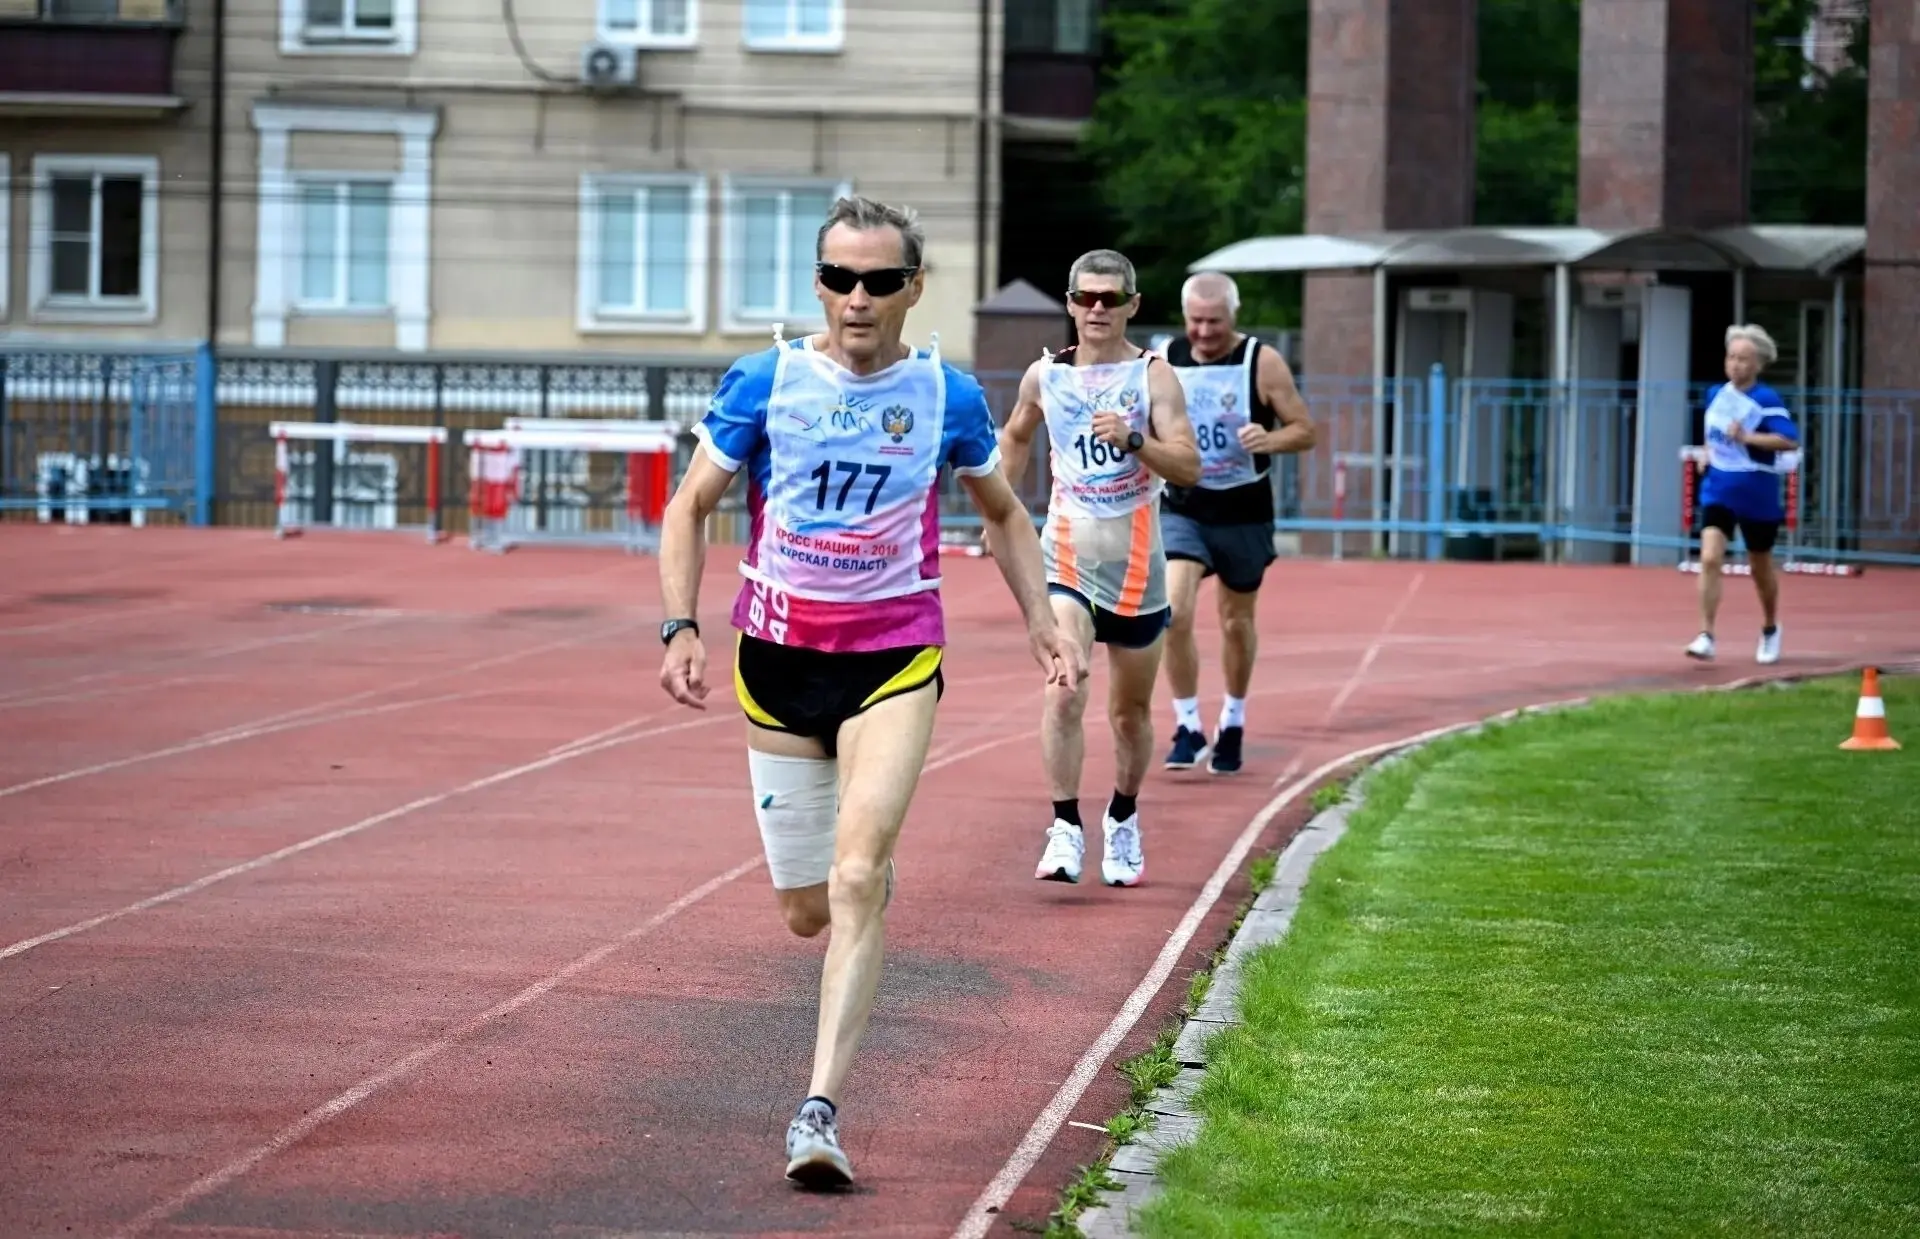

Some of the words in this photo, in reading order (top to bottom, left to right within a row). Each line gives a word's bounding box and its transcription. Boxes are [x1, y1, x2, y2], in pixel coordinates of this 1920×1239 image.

[811, 460, 892, 515] 177
[776, 527, 810, 547] КРОСС
[815, 539, 860, 556] НАЦИИ
[780, 545, 829, 567] КУРСКАЯ
[833, 558, 888, 571] ОБЛАСТЬ
